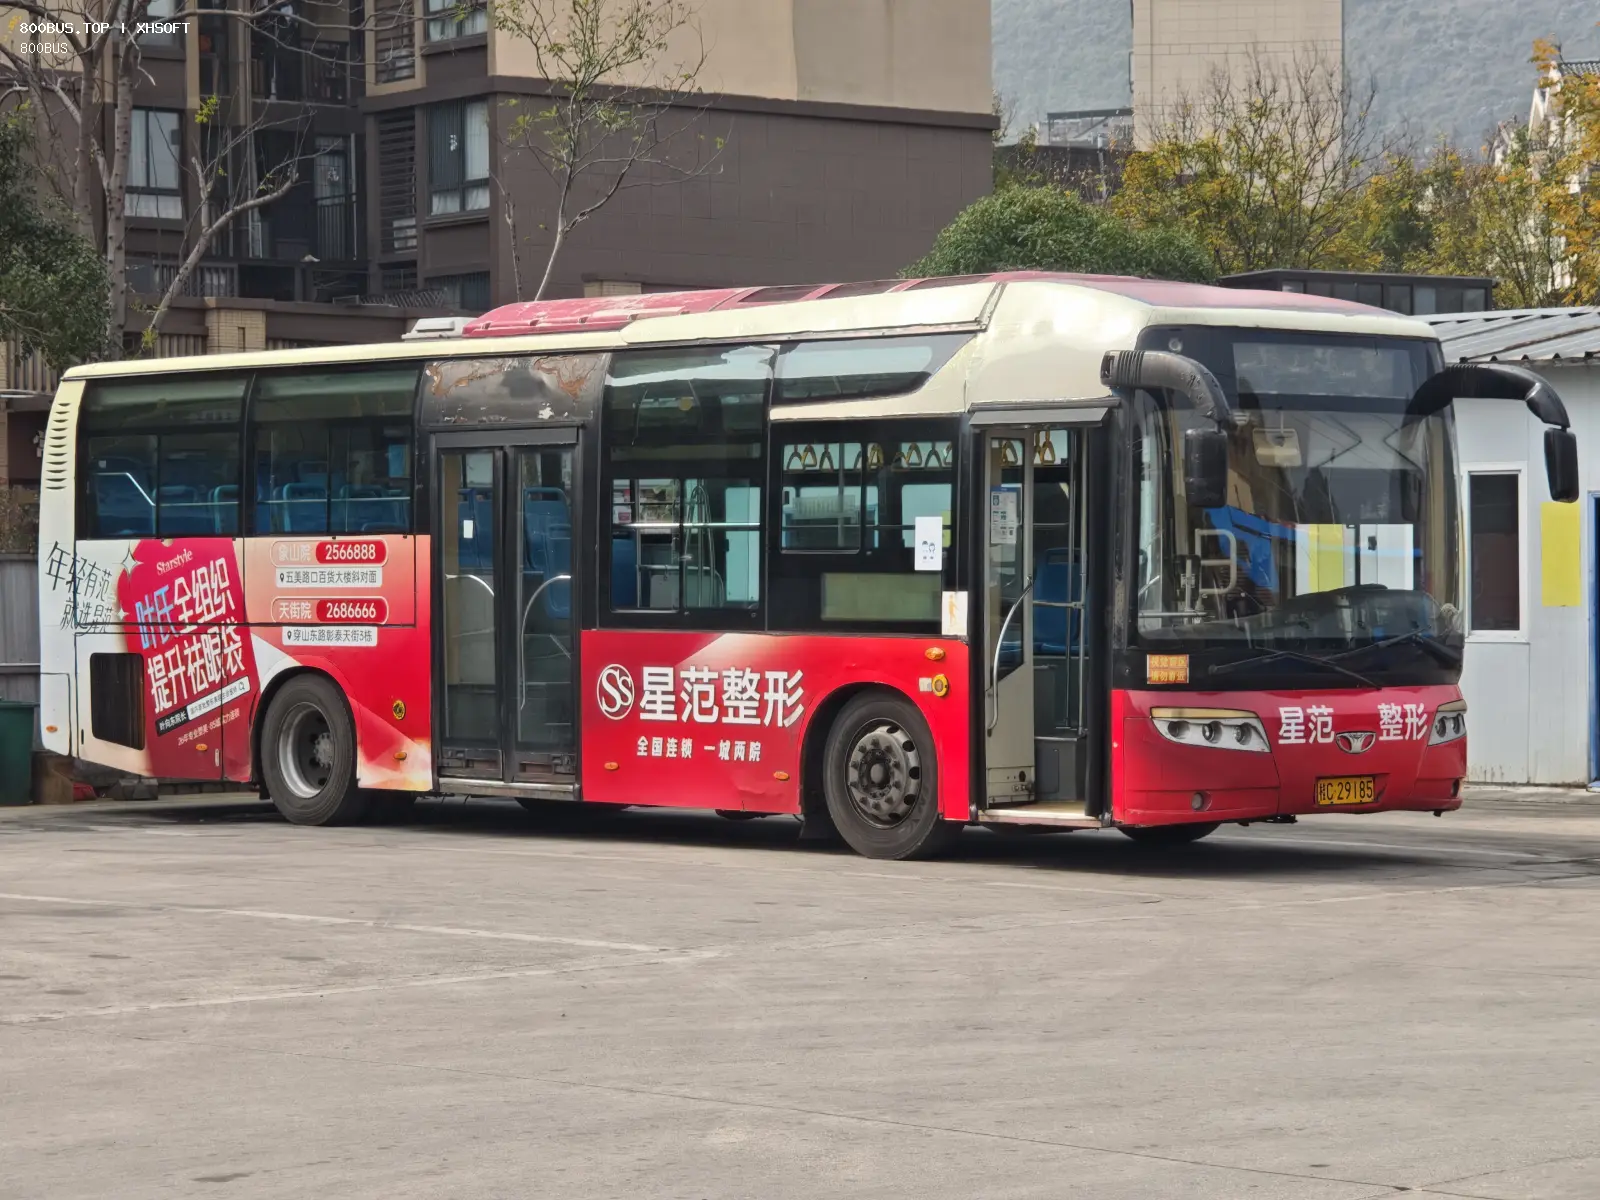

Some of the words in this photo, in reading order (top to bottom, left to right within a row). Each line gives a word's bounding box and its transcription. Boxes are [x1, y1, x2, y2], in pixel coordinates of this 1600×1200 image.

[156, 548, 193, 576] Starstyle
[325, 543, 376, 560] 2566888
[286, 569, 377, 584] 五美路口百货大楼斜对面
[279, 602, 312, 620] 天街院
[326, 602, 377, 619] 2686666
[293, 629, 373, 642] 穿山东路彰泰天街3栋
[147, 616, 246, 714] 提升祛眼袋
[639, 665, 805, 728] 星范整形
[1278, 704, 1335, 744] 星范
[1377, 702, 1428, 741] 整形
[636, 735, 693, 759] 全国连锁
[703, 739, 761, 762] 一城两院
